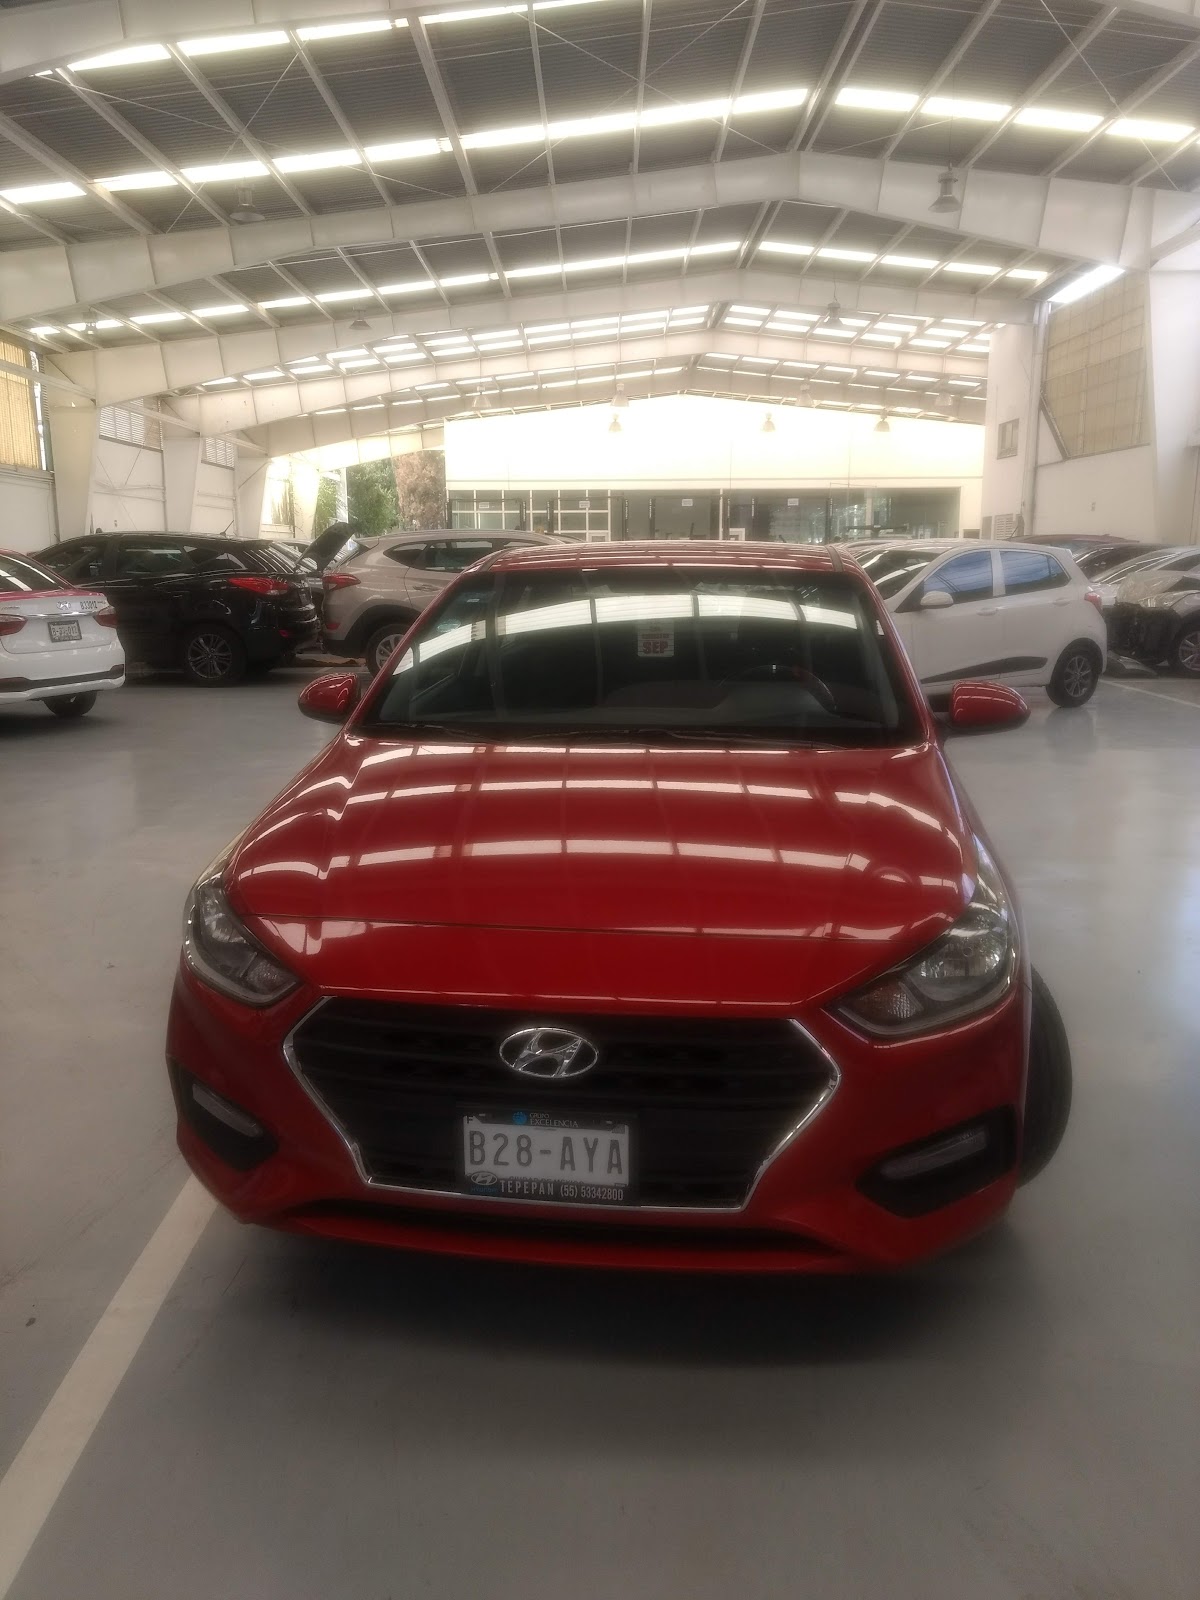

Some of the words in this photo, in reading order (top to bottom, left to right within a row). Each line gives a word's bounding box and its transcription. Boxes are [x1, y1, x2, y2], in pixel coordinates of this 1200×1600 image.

[642, 641, 669, 655] SEP
[529, 1118, 579, 1128] EXCELENCIA
[469, 1130, 623, 1175] B28-AYA
[500, 1180, 554, 1195] TEPEPAN
[560, 1185, 578, 1198] (55)
[581, 1184, 624, 1201] 53342800
